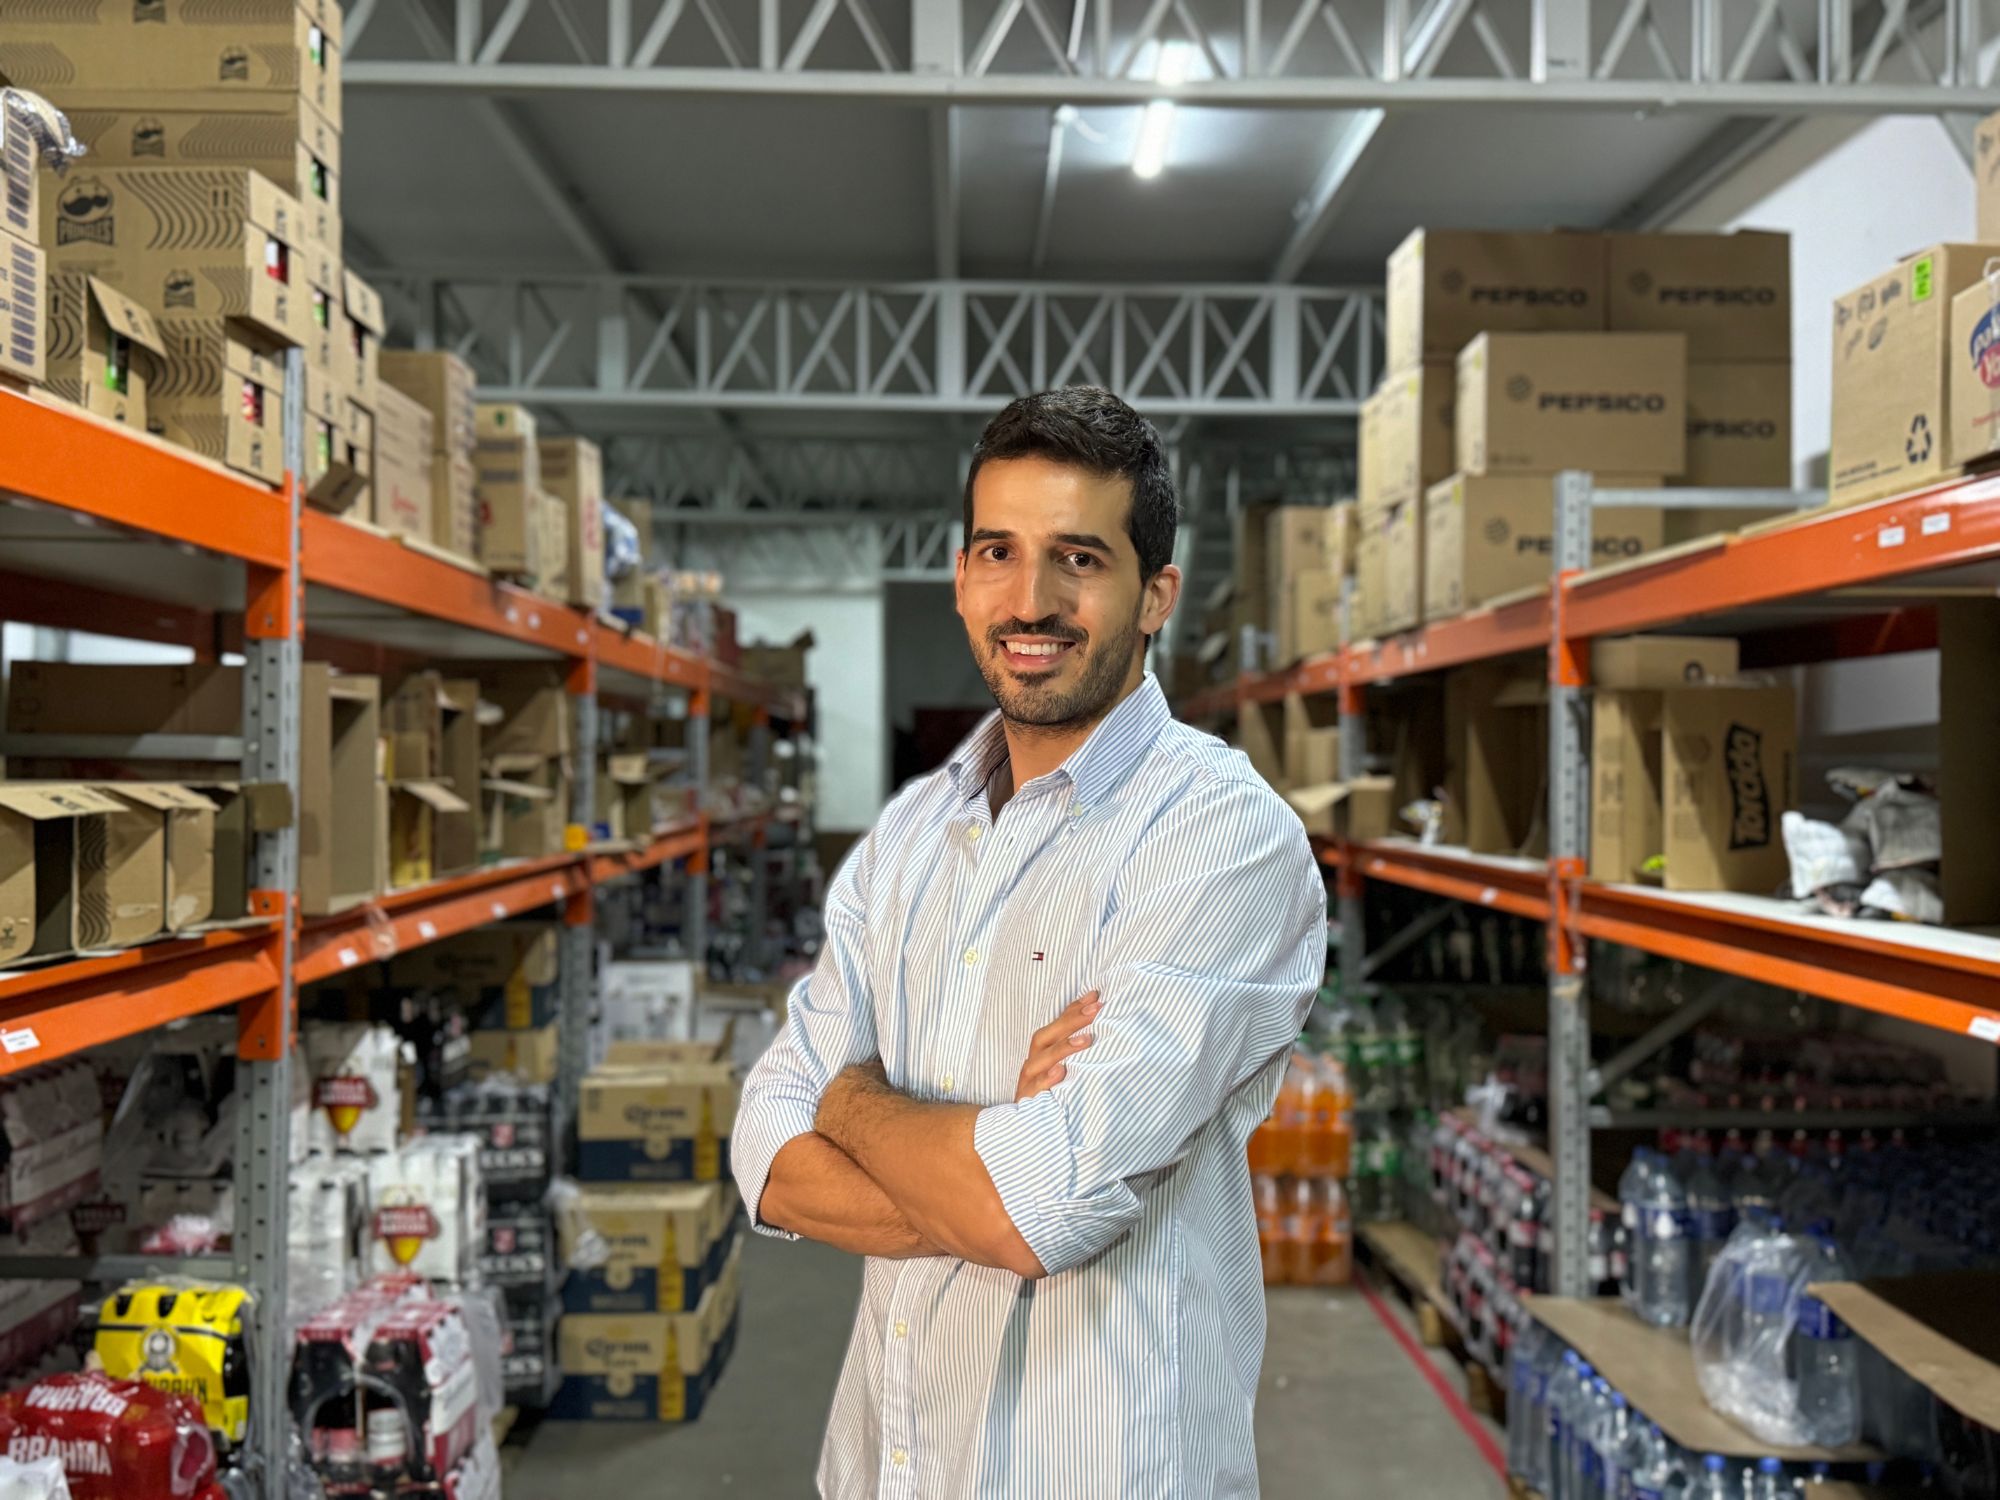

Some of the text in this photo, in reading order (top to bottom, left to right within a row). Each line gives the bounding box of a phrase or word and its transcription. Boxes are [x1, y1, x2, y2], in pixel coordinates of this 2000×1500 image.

[1470, 286, 1589, 307] PEPSICO
[1659, 286, 1776, 306] PEPSICO
[1538, 393, 1665, 412] PEPSICO
[1517, 536, 1642, 557] PEICO
[25, 1383, 128, 1418] BRAHMA
[8, 1436, 112, 1475] BRAHMA
